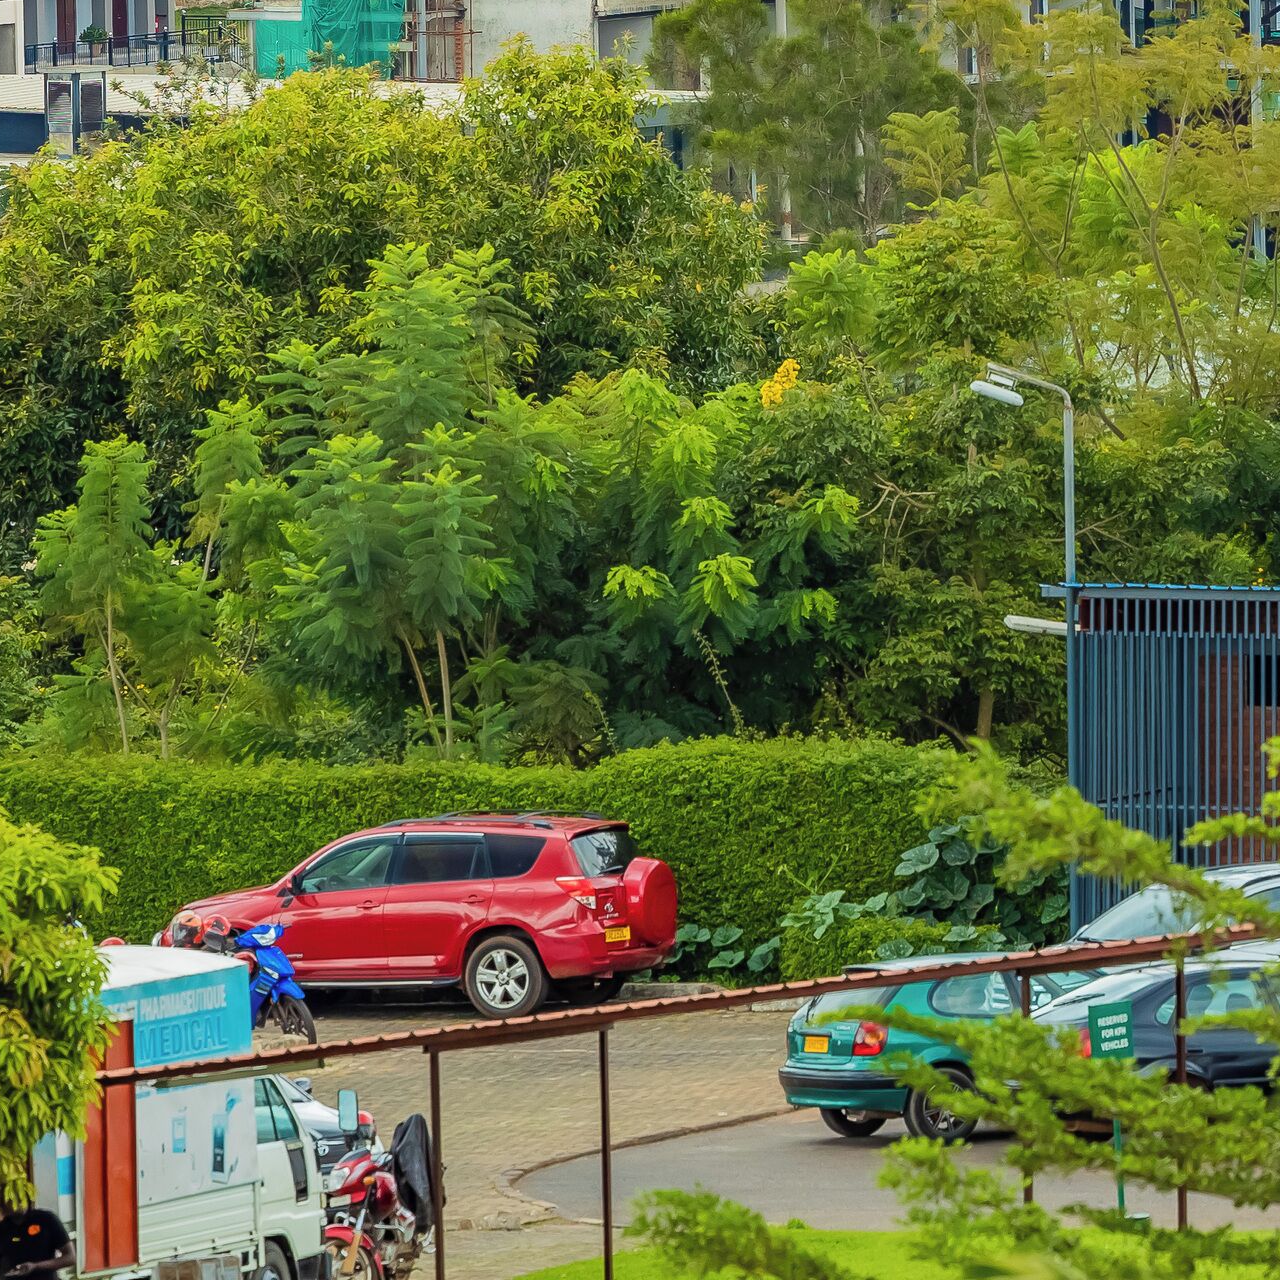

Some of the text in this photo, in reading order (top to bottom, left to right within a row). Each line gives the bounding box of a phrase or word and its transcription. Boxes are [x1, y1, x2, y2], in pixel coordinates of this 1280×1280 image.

[139, 984, 227, 1021] PHARMACEUTIQUE
[1097, 1013, 1128, 1027] RESERVED
[139, 1016, 228, 1062] MEDICAL
[1101, 1028, 1114, 1039] FOR
[1101, 1037, 1129, 1051] VEHICLES
